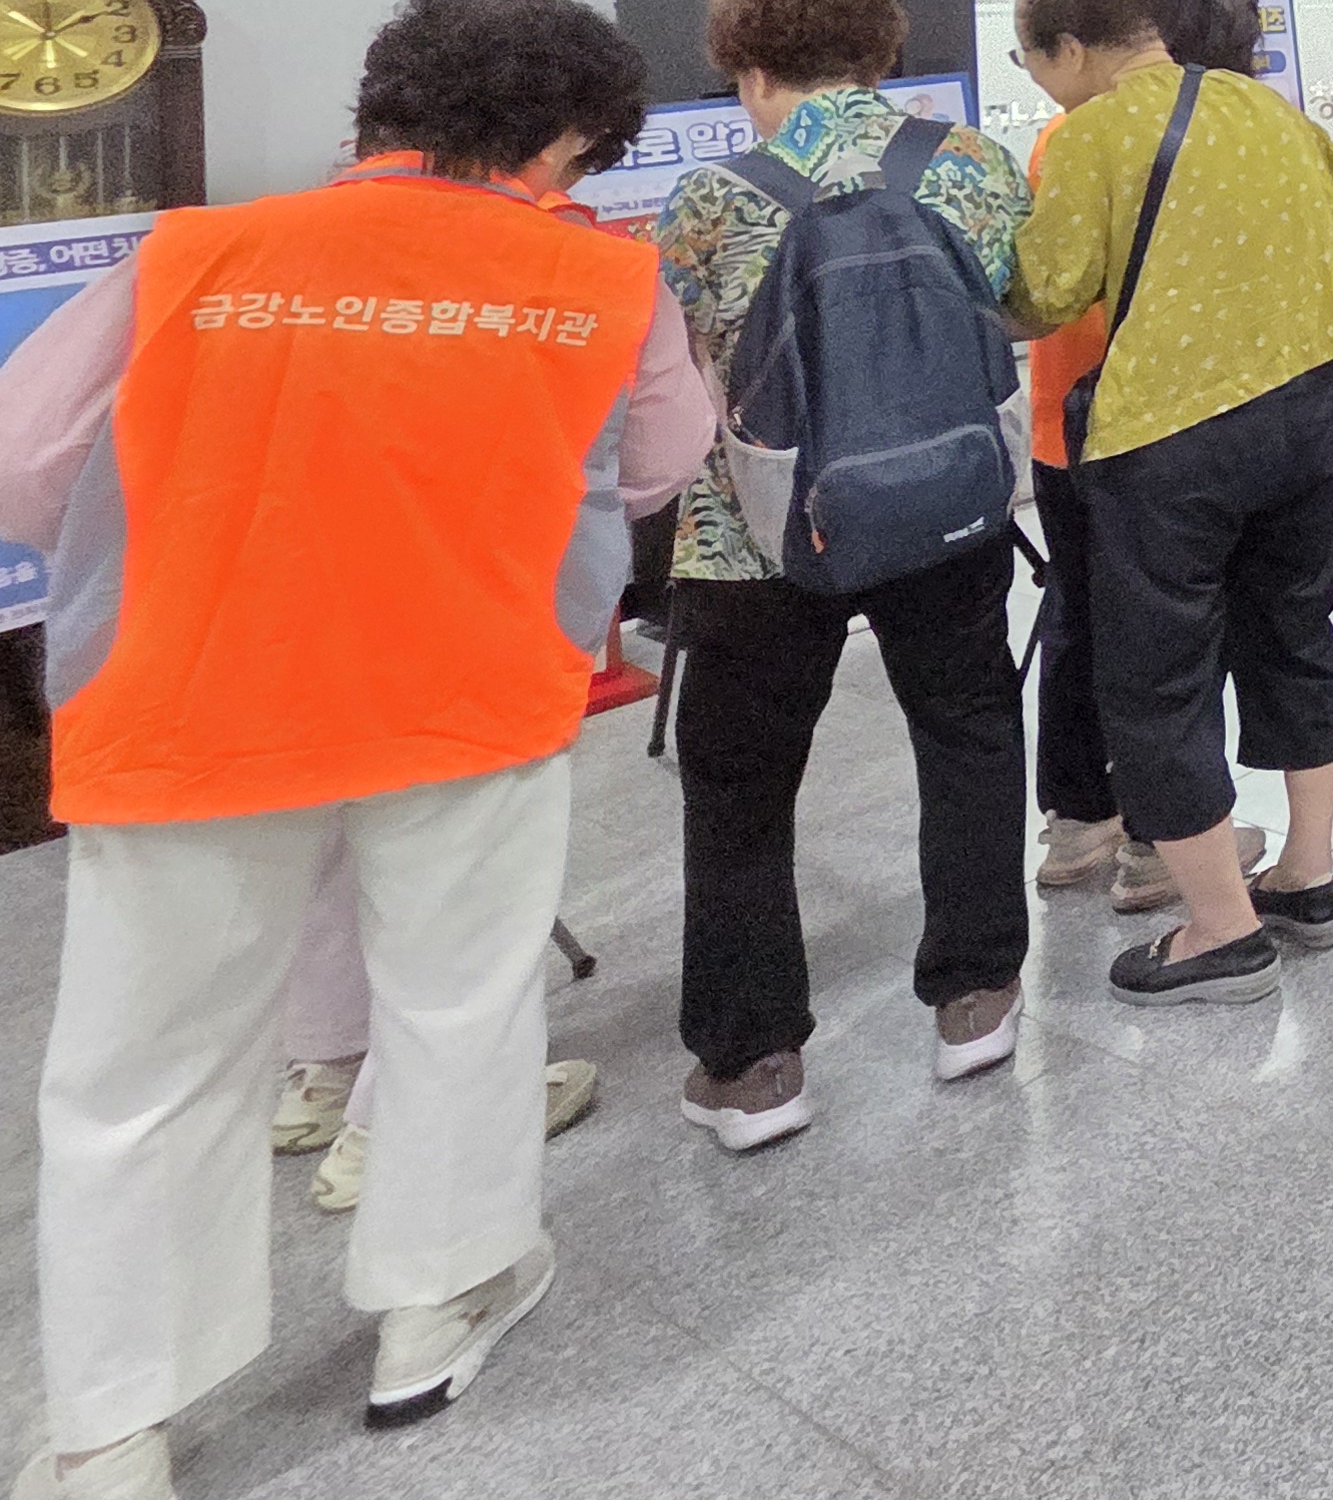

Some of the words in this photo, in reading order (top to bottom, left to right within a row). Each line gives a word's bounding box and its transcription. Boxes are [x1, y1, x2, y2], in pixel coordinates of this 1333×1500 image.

[105, 0, 131, 16] 2
[113, 25, 137, 43] 3
[101, 50, 126, 67] 4
[0, 73, 22, 90] 7
[34, 76, 62, 95] 6
[74, 70, 100, 88] 5
[50, 239, 111, 266] 어떤
[190, 291, 599, 347] 금강노인종합복지관
